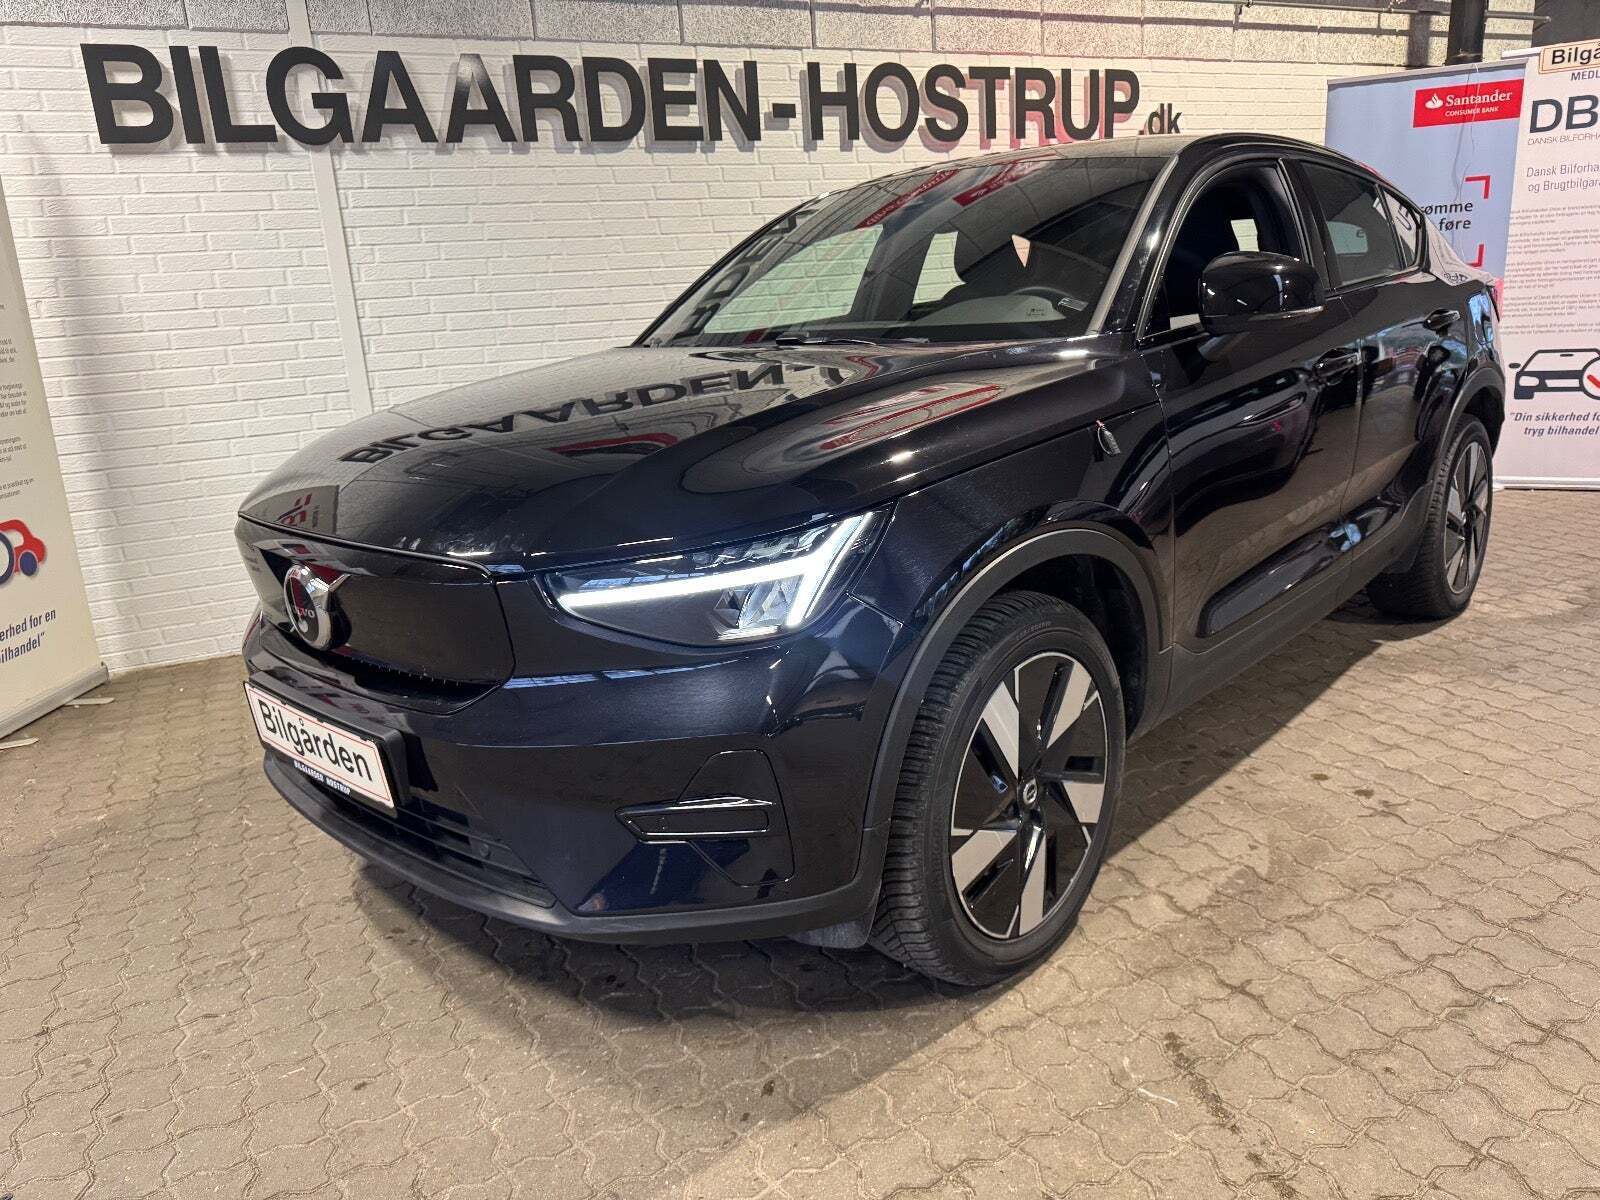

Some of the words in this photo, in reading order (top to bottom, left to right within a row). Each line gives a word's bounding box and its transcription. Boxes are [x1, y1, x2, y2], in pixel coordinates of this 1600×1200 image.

[1445, 89, 1512, 107] Santander
[1444, 107, 1481, 117] CONSUMER
[1482, 105, 1499, 114] BANK
[1529, 94, 1600, 133] DB
[1528, 136, 1558, 146] DANSK
[1527, 165, 1557, 178] Dansk
[1528, 183, 1541, 194] og
[1543, 178, 1600, 192] Brugtbilgar
[1439, 217, 1472, 231] føre
[1535, 411, 1590, 422] sikkerhed
[1524, 426, 1545, 437] tryg
[29, 614, 43, 629] for
[44, 609, 57, 623] en
[0, 631, 46, 664] ilhandel"
[258, 698, 374, 783] Bilgården
